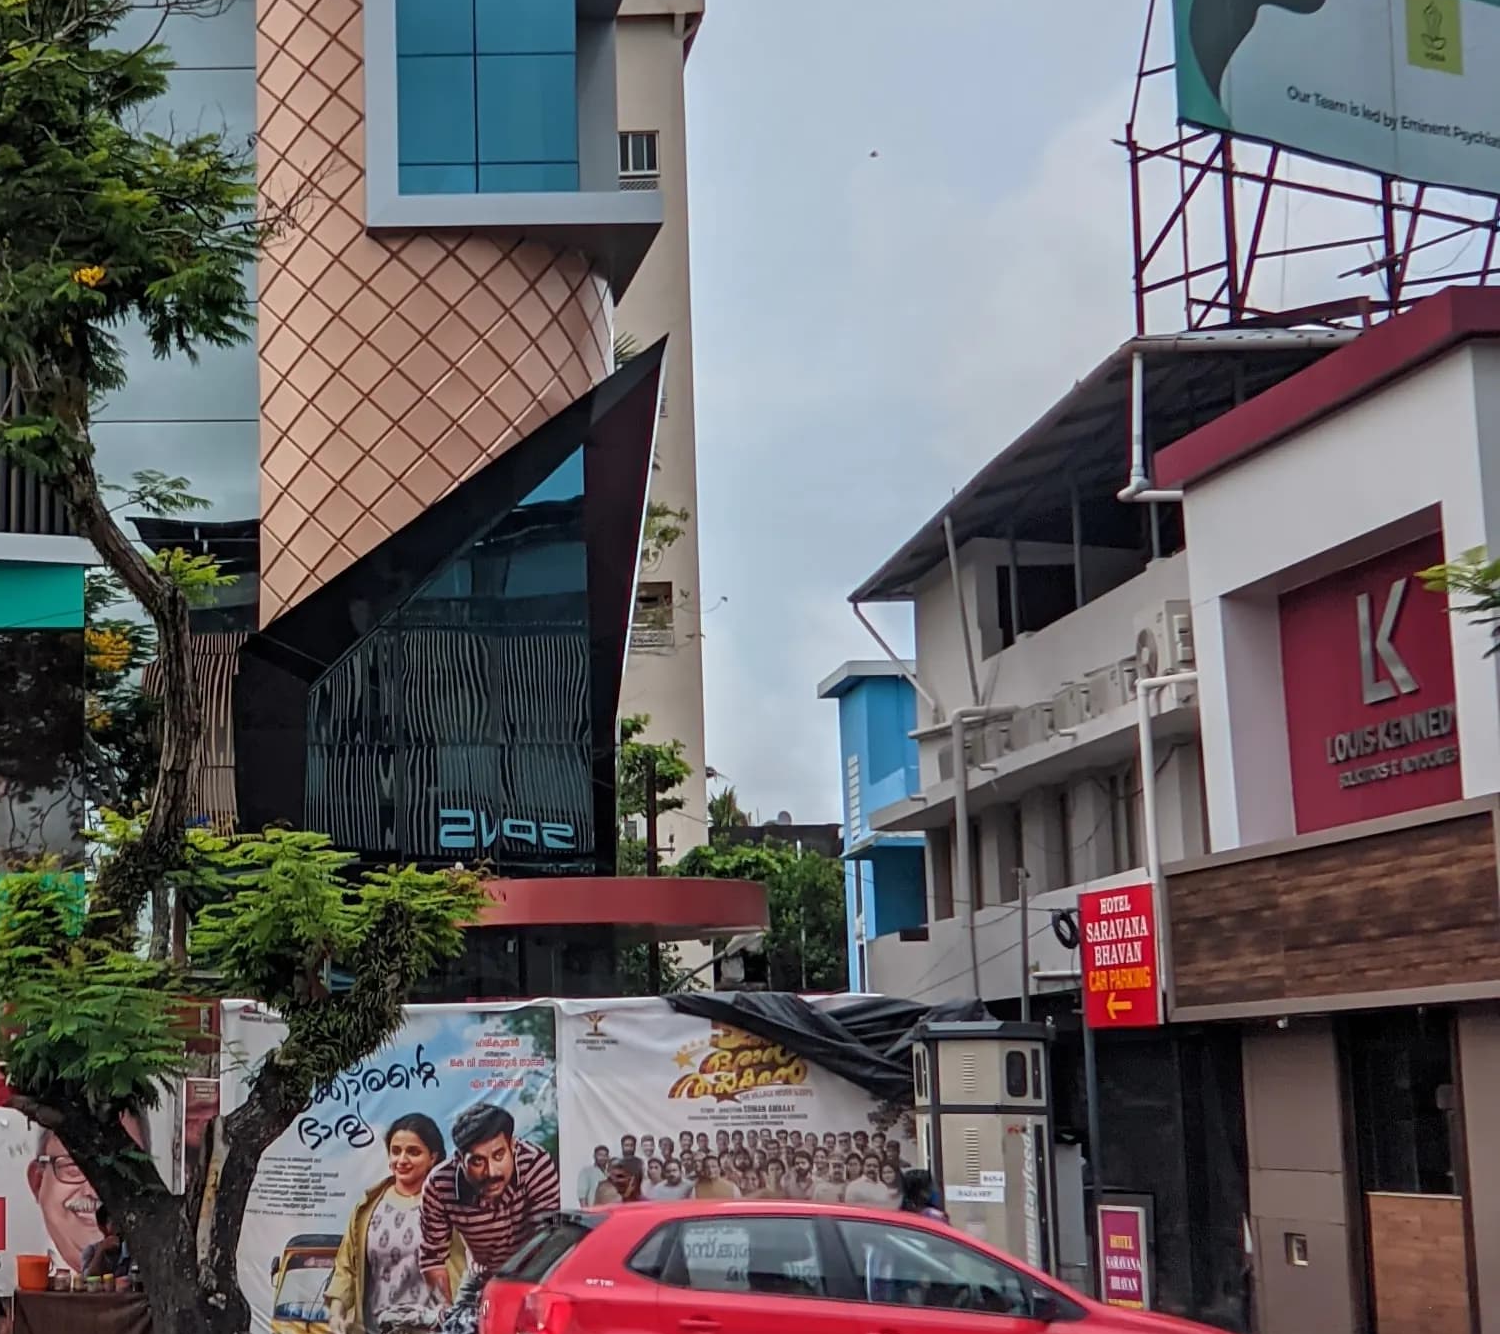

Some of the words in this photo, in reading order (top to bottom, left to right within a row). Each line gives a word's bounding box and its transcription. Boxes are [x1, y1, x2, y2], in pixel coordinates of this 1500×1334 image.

[1287, 85, 1310, 103] Our
[1314, 93, 1348, 114] Team
[1350, 102, 1360, 117] is
[1383, 113, 1398, 131] by
[1401, 116, 1451, 137] Eminent
[1100, 895, 1131, 915] HOTEL
[1086, 915, 1149, 943] SARAVANA
[1094, 941, 1142, 966] BHAVAN
[1089, 970, 1108, 992] CAR
[1109, 967, 1152, 990] PARKING
[1109, 1234, 1134, 1250] HOTEL
[1109, 1275, 1138, 1291] BHAVAN
